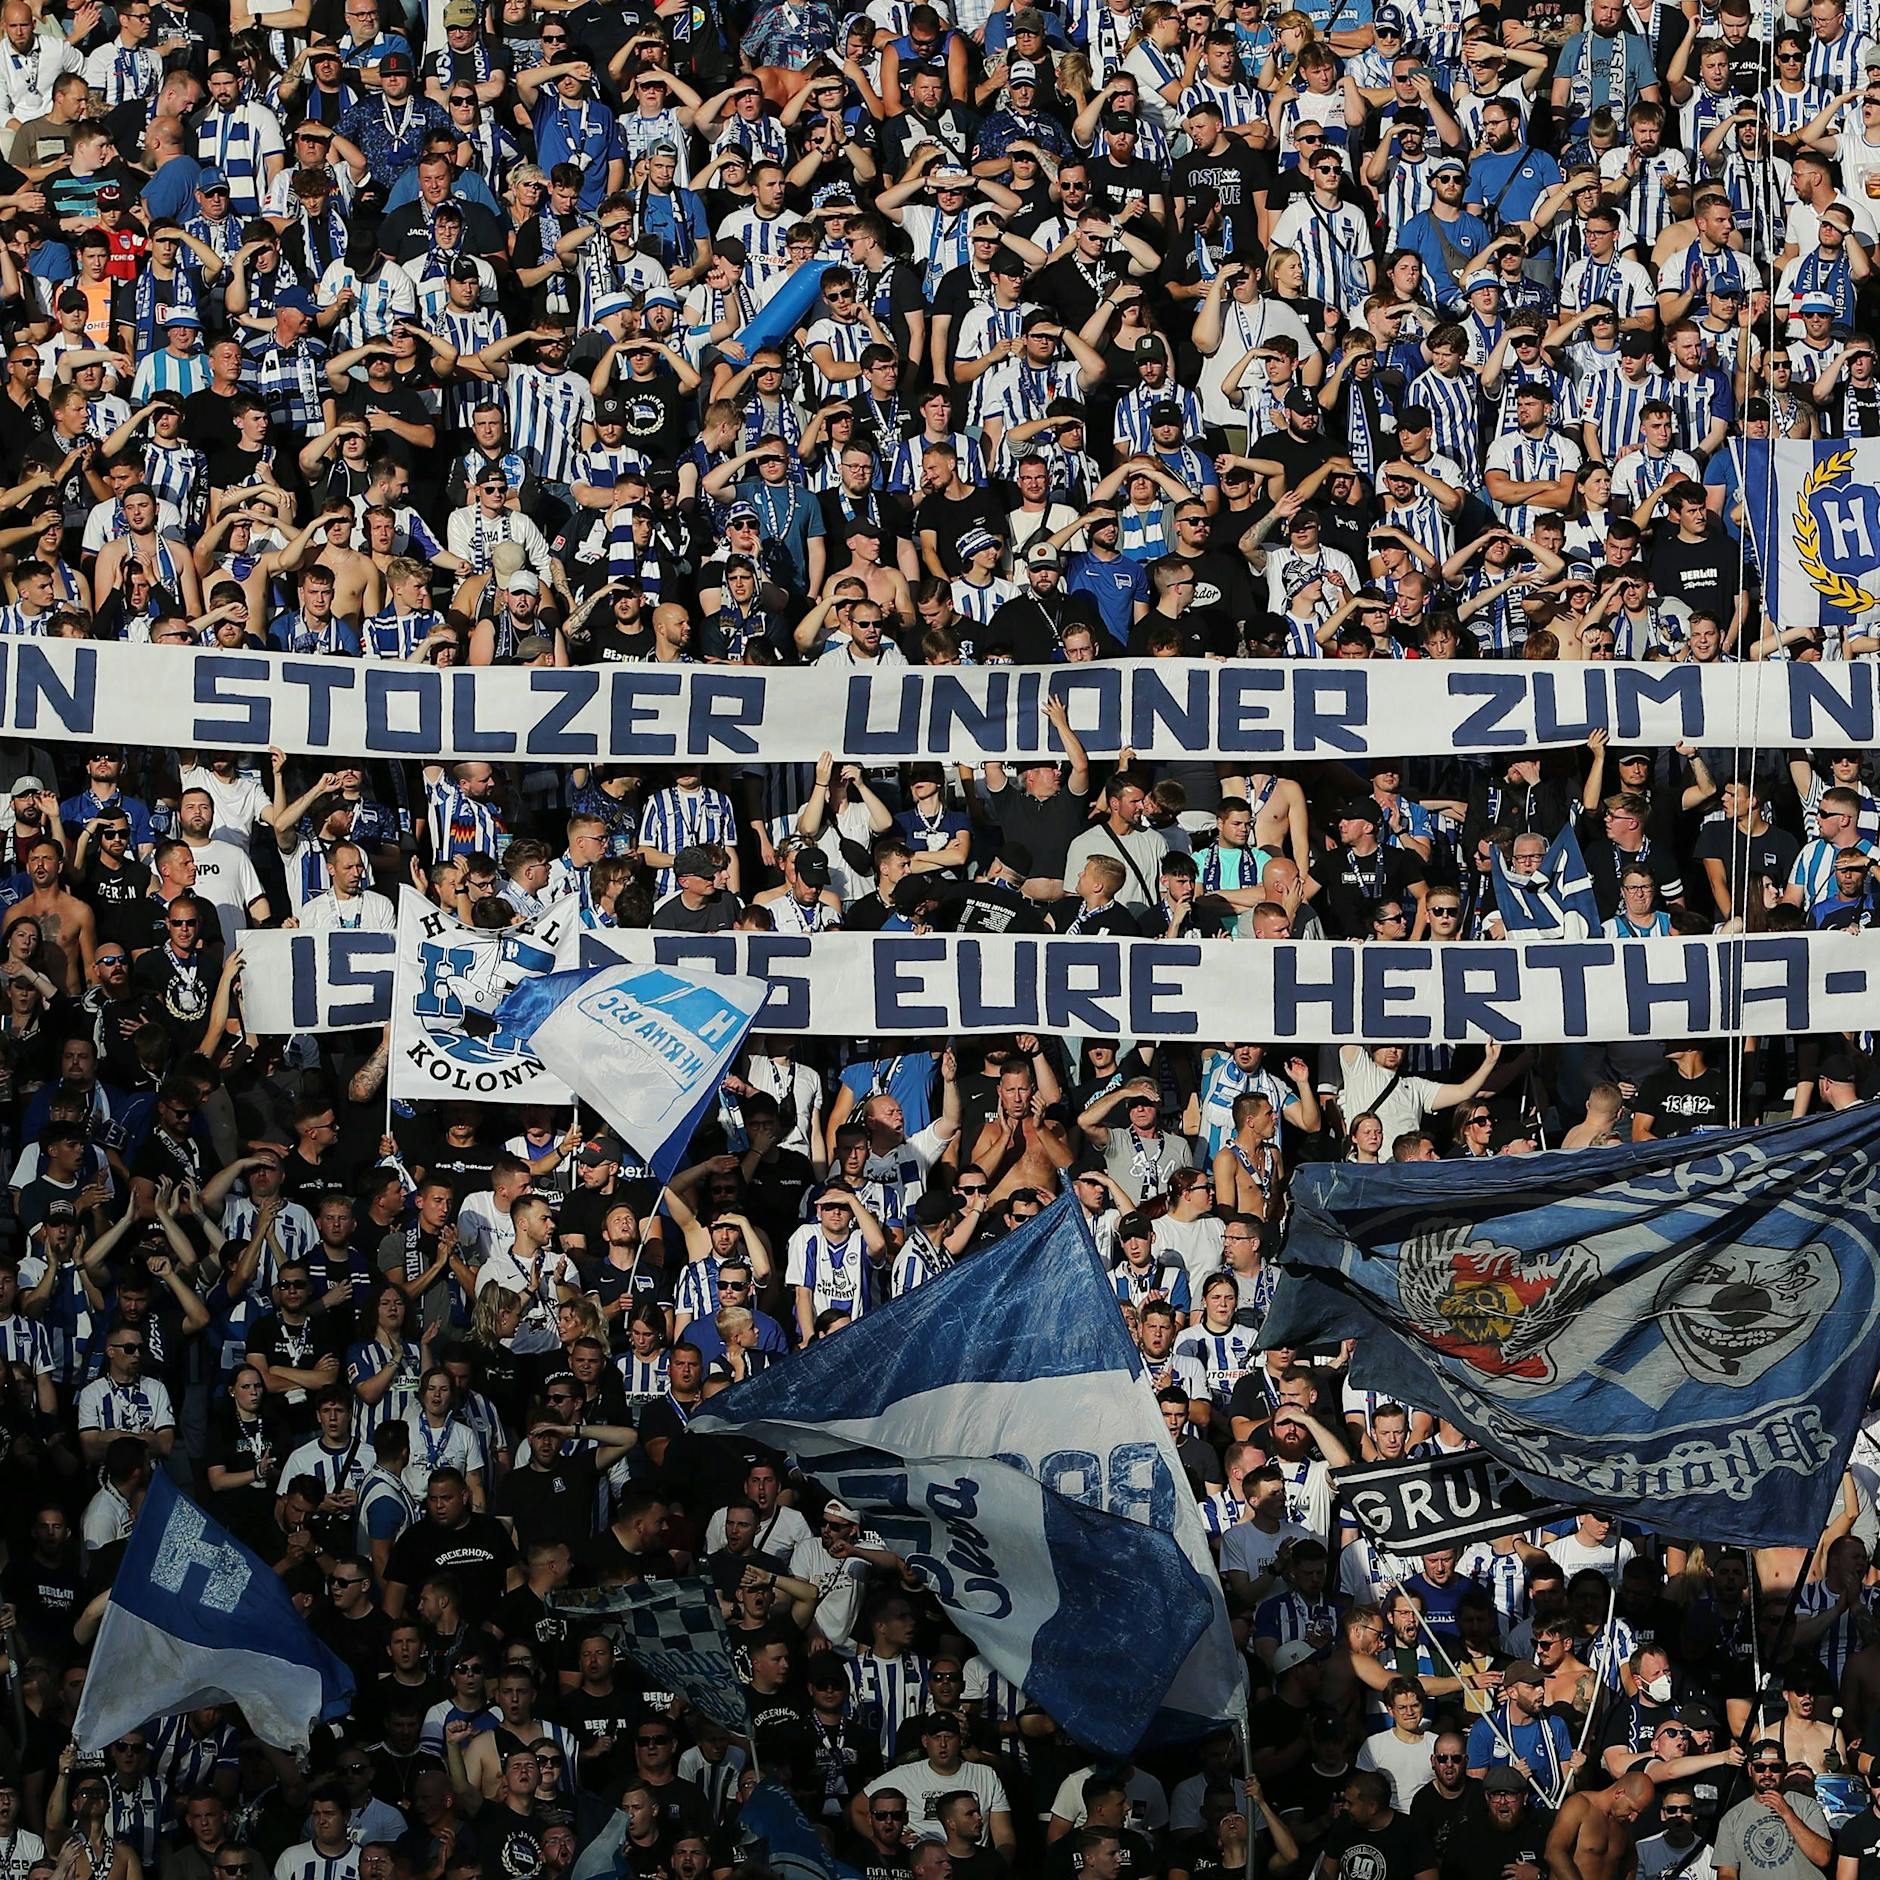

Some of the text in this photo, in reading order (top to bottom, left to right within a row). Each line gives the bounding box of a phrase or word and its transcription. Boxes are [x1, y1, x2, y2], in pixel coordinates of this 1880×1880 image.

[1680, 568, 1718, 581] BERLIN
[193, 655, 766, 756] STOLZER
[843, 668, 1368, 755] UNIONER
[1447, 665, 1704, 747] ZUM
[1787, 662, 1880, 742] N
[420, 911, 561, 948] HEL
[873, 938, 1201, 1034] EURE
[436, 1548, 494, 1567] DREIERHOPP
[584, 1718, 628, 1731] BERN
